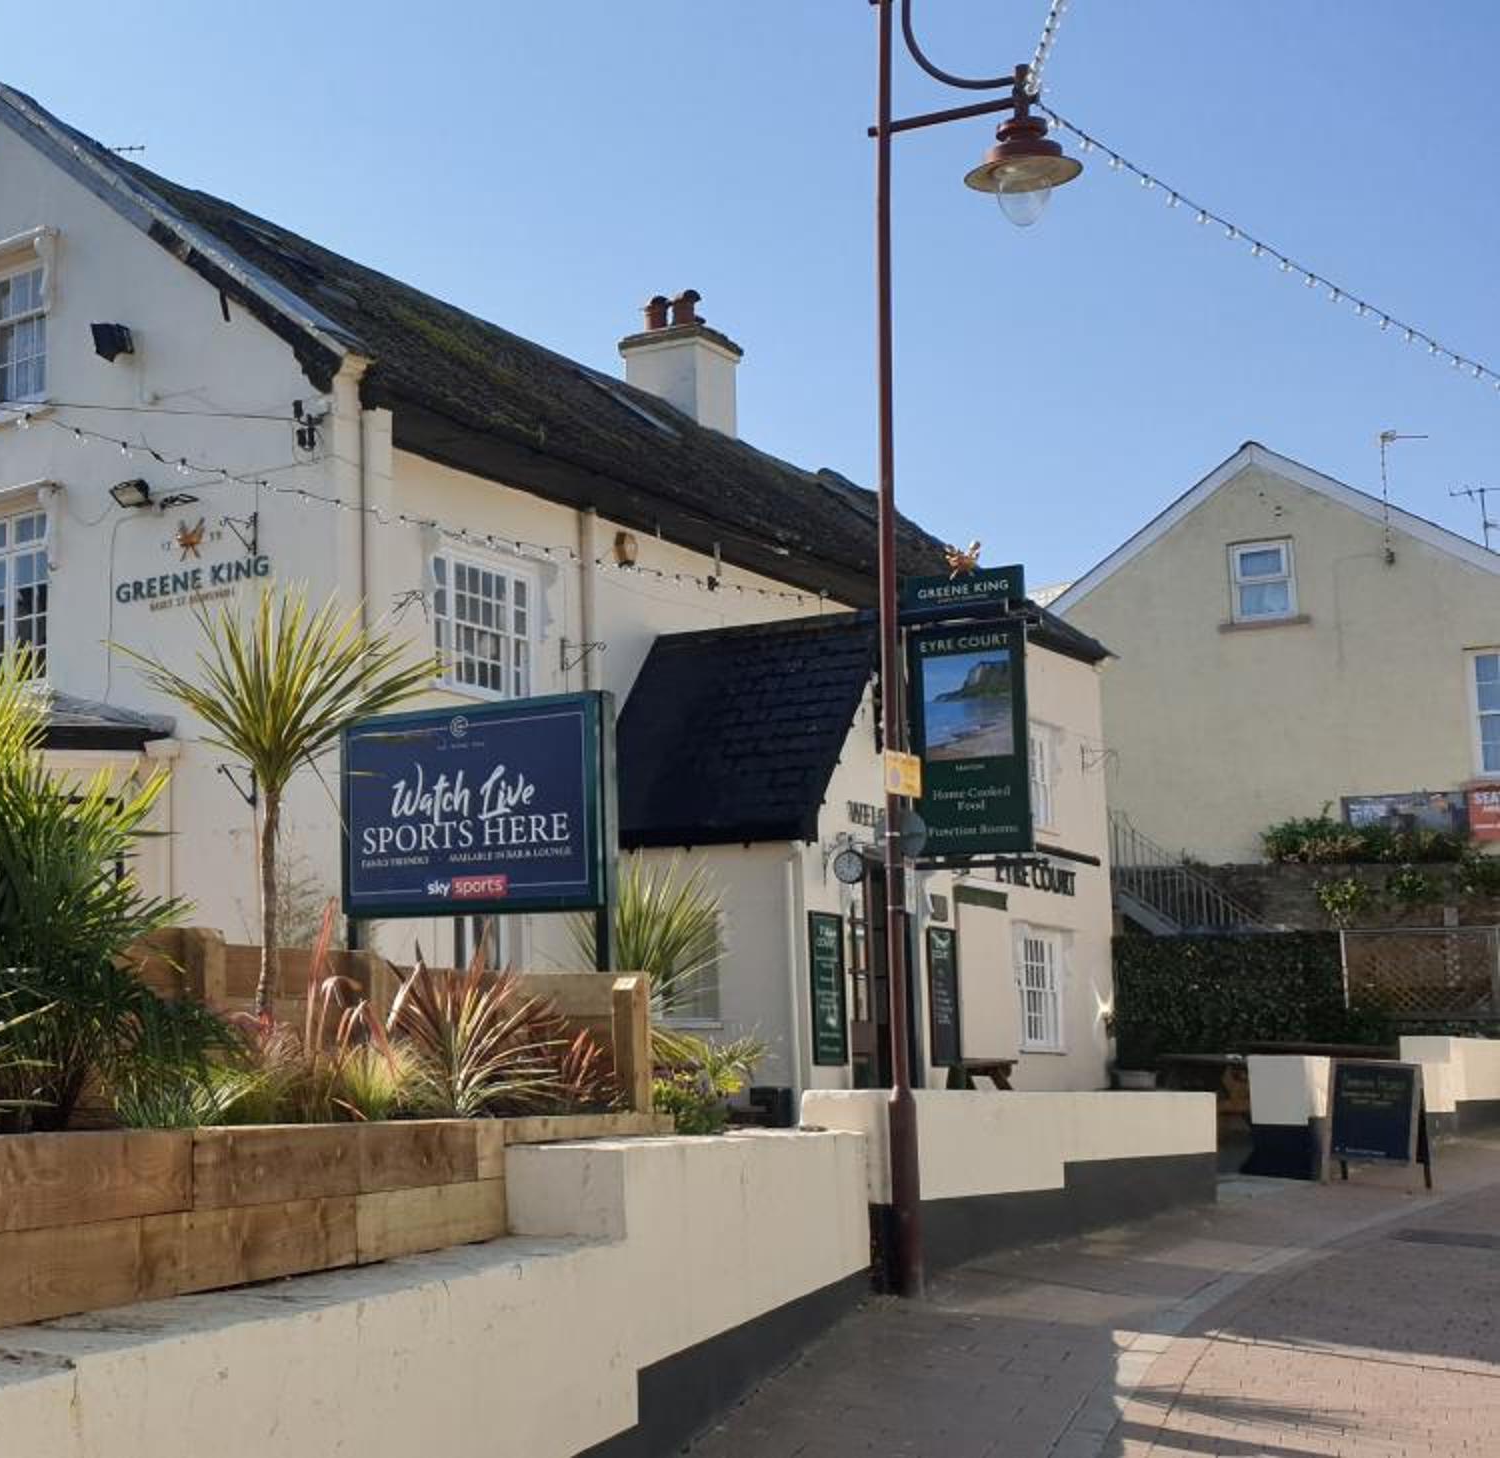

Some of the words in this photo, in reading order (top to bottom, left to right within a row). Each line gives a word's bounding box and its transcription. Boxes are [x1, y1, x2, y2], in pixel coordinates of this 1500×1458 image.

[115, 568, 202, 603] GREENE
[210, 555, 270, 586] KING
[917, 583, 970, 599] GREENE
[974, 579, 1009, 593] KING
[920, 638, 955, 653] EYRE
[958, 633, 1008, 649] COURT
[391, 763, 469, 826] Watch
[478, 764, 536, 821] Live
[362, 819, 474, 855] SPORTS
[483, 812, 571, 847] HERE
[427, 880, 450, 897] sky
[454, 877, 504, 898] sports
